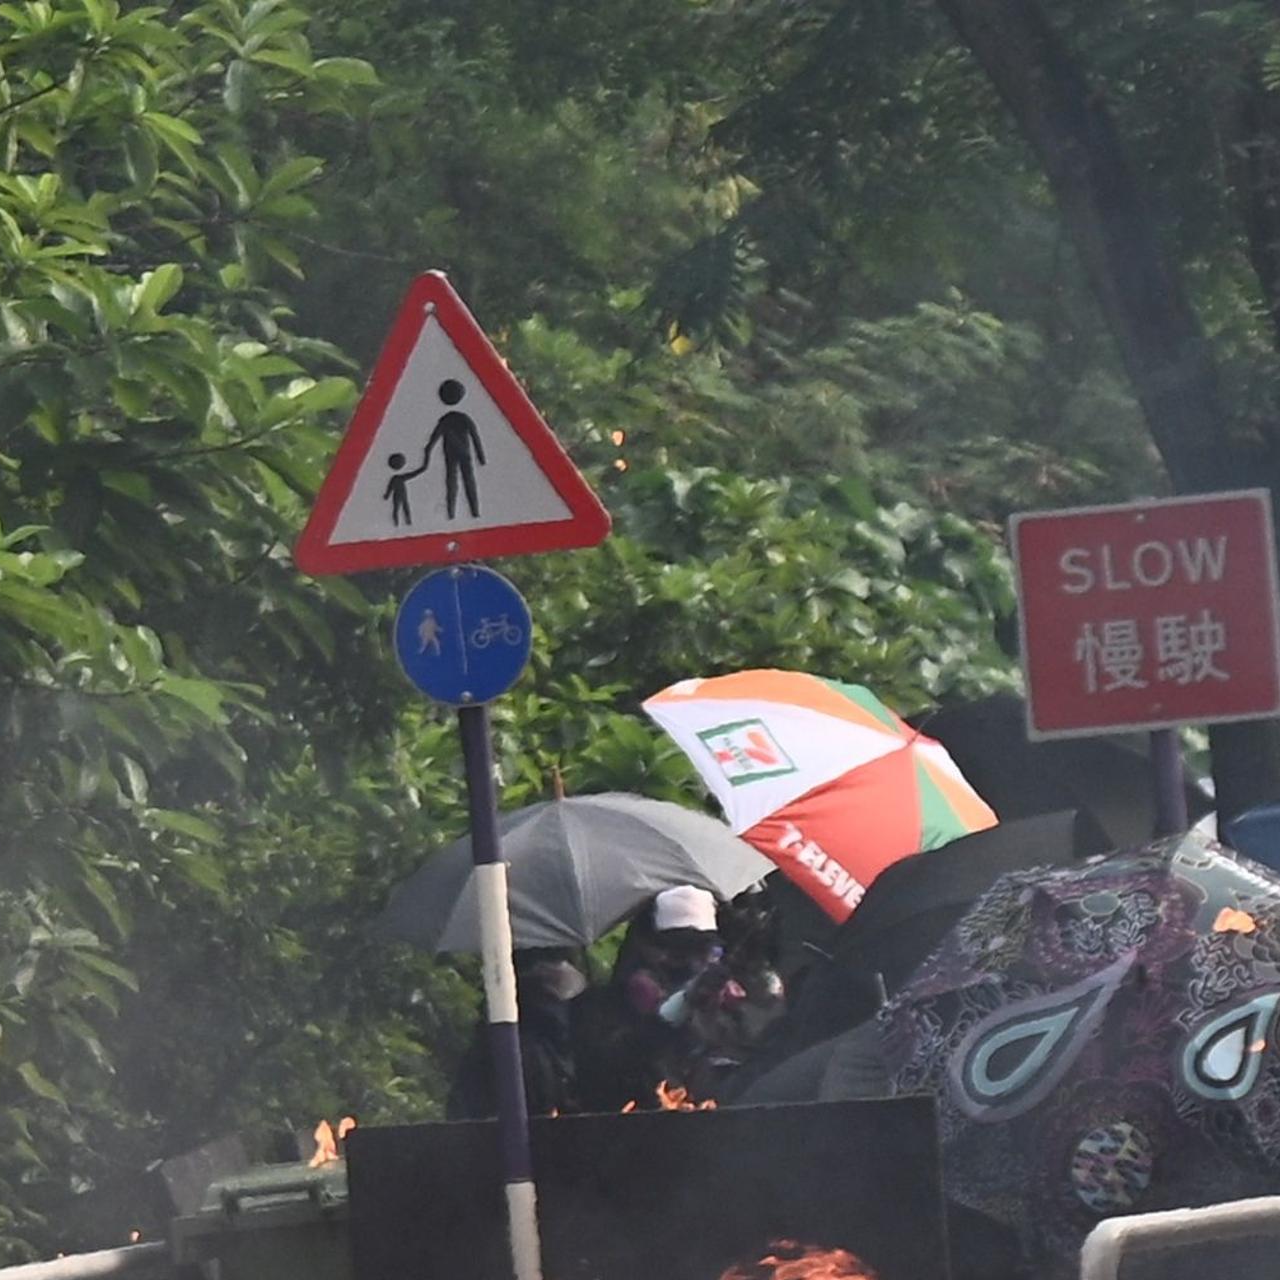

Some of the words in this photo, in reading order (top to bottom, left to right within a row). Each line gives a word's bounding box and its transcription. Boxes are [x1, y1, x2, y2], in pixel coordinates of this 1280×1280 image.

[1059, 536, 1227, 594] SLOW
[1075, 609, 1230, 693] 慢駛
[778, 821, 866, 909] 7-ELEVE
